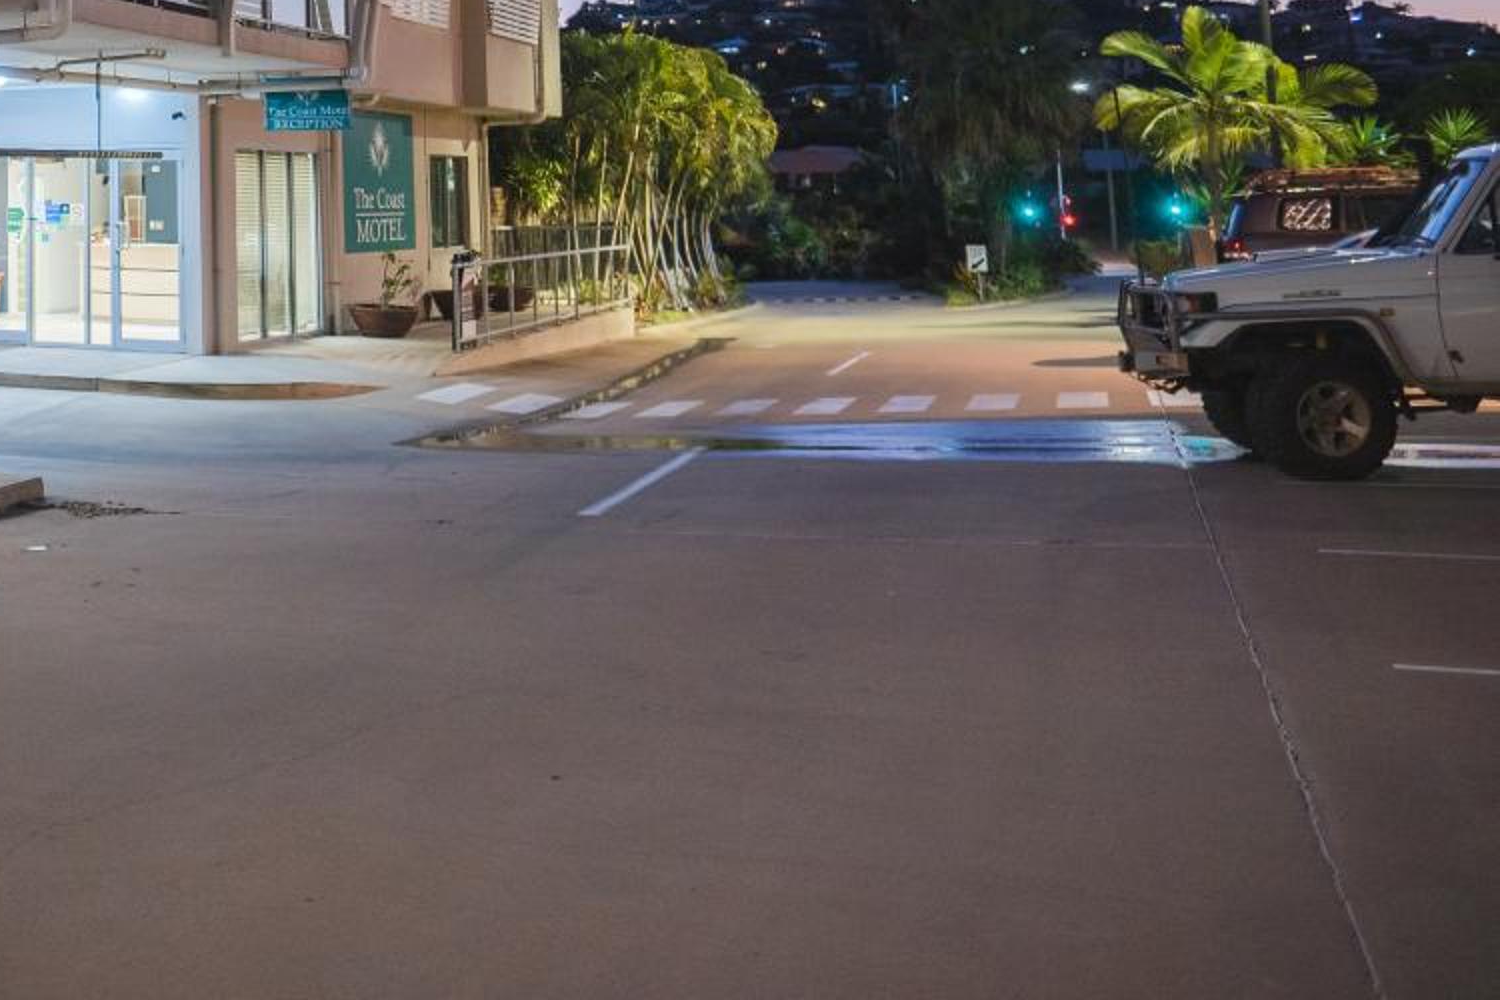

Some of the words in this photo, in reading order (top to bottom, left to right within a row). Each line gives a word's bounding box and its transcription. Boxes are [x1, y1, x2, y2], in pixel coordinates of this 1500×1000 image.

[289, 104, 318, 118] Coast
[273, 117, 345, 131] RECEPTION
[354, 187, 374, 209] The
[376, 187, 405, 209] Coast
[356, 218, 405, 243] MOTEL
